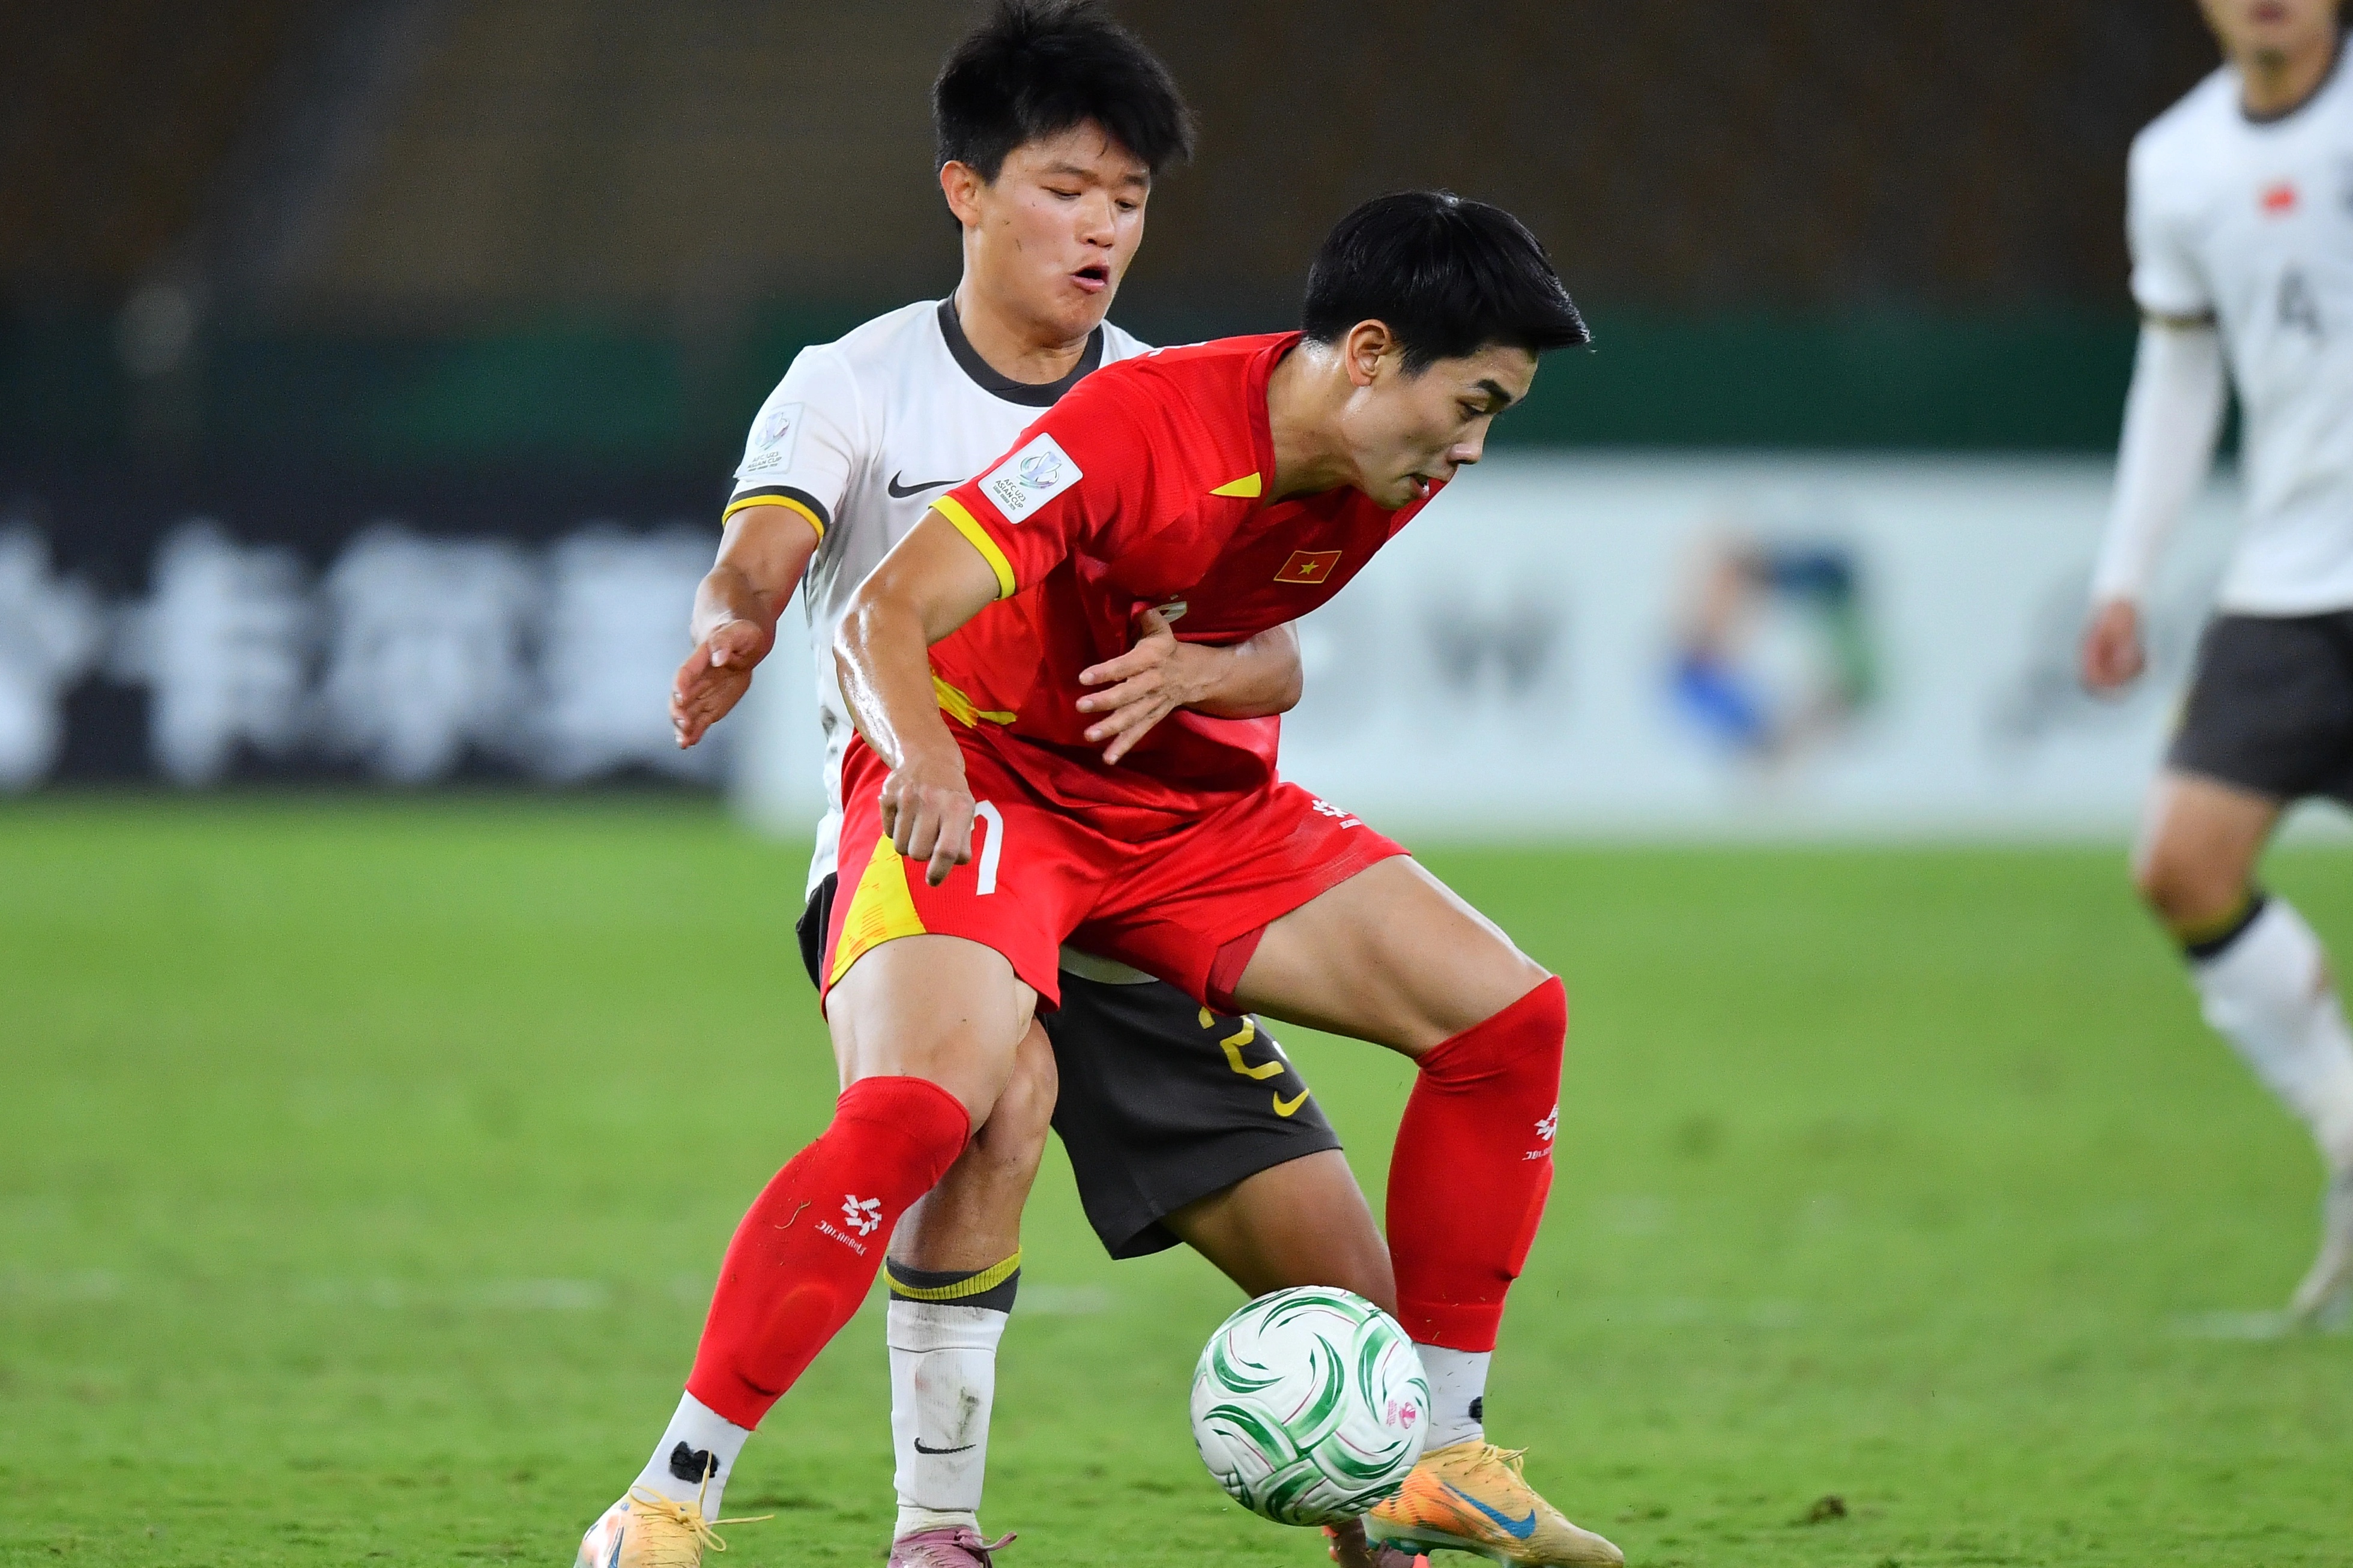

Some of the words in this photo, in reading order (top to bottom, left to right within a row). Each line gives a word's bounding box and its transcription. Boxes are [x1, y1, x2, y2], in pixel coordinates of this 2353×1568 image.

[748, 459, 767, 468] ASIAN
[995, 480, 1013, 498] ASIAN
[1011, 496, 1024, 508] CUP
[1003, 478, 1016, 491] AFC
[1015, 489, 1026, 502] U23
[1198, 1006, 1288, 1080] 2
